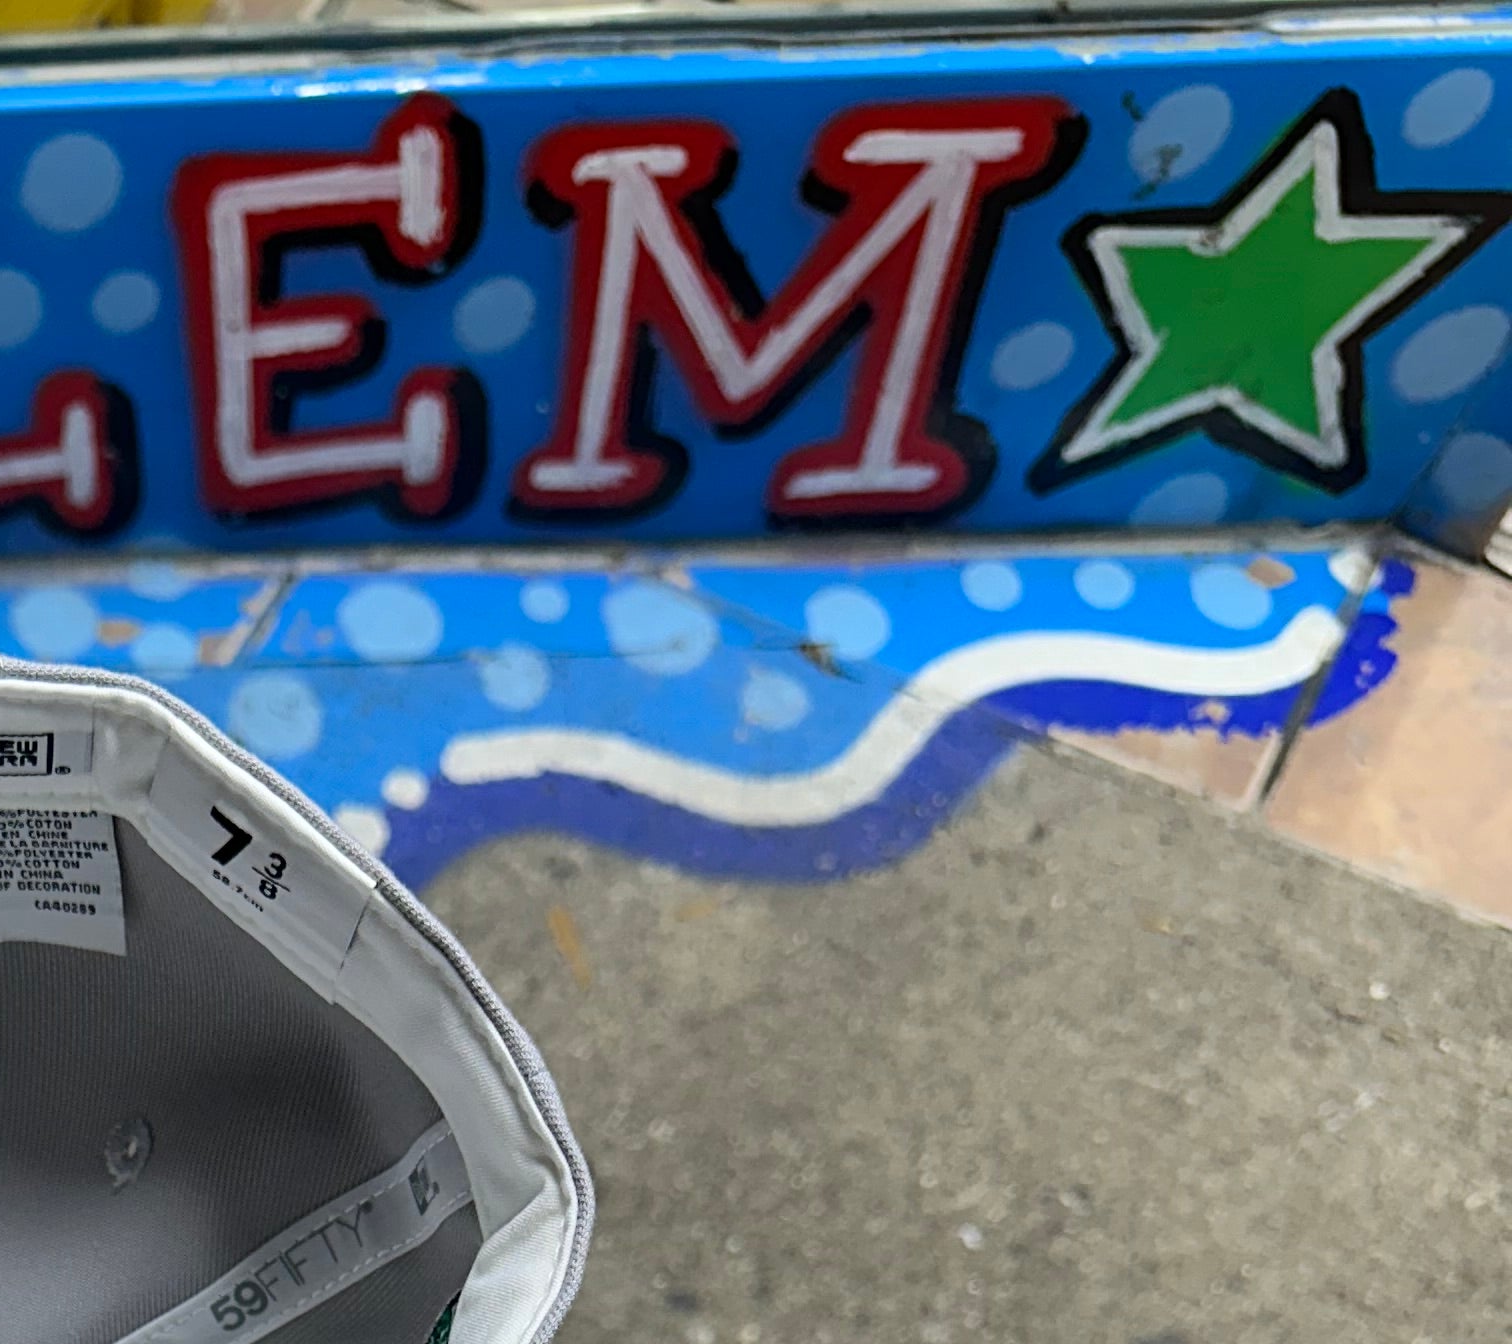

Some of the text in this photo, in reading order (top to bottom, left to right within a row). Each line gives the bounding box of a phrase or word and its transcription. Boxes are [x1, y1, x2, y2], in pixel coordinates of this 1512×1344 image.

[210, 804, 253, 867] 7
[23, 859, 81, 871] COTTON
[19, 869, 65, 880] CHINA
[16, 881, 102, 896] DECORATION
[210, 1207, 366, 1332] 59FIFTY
